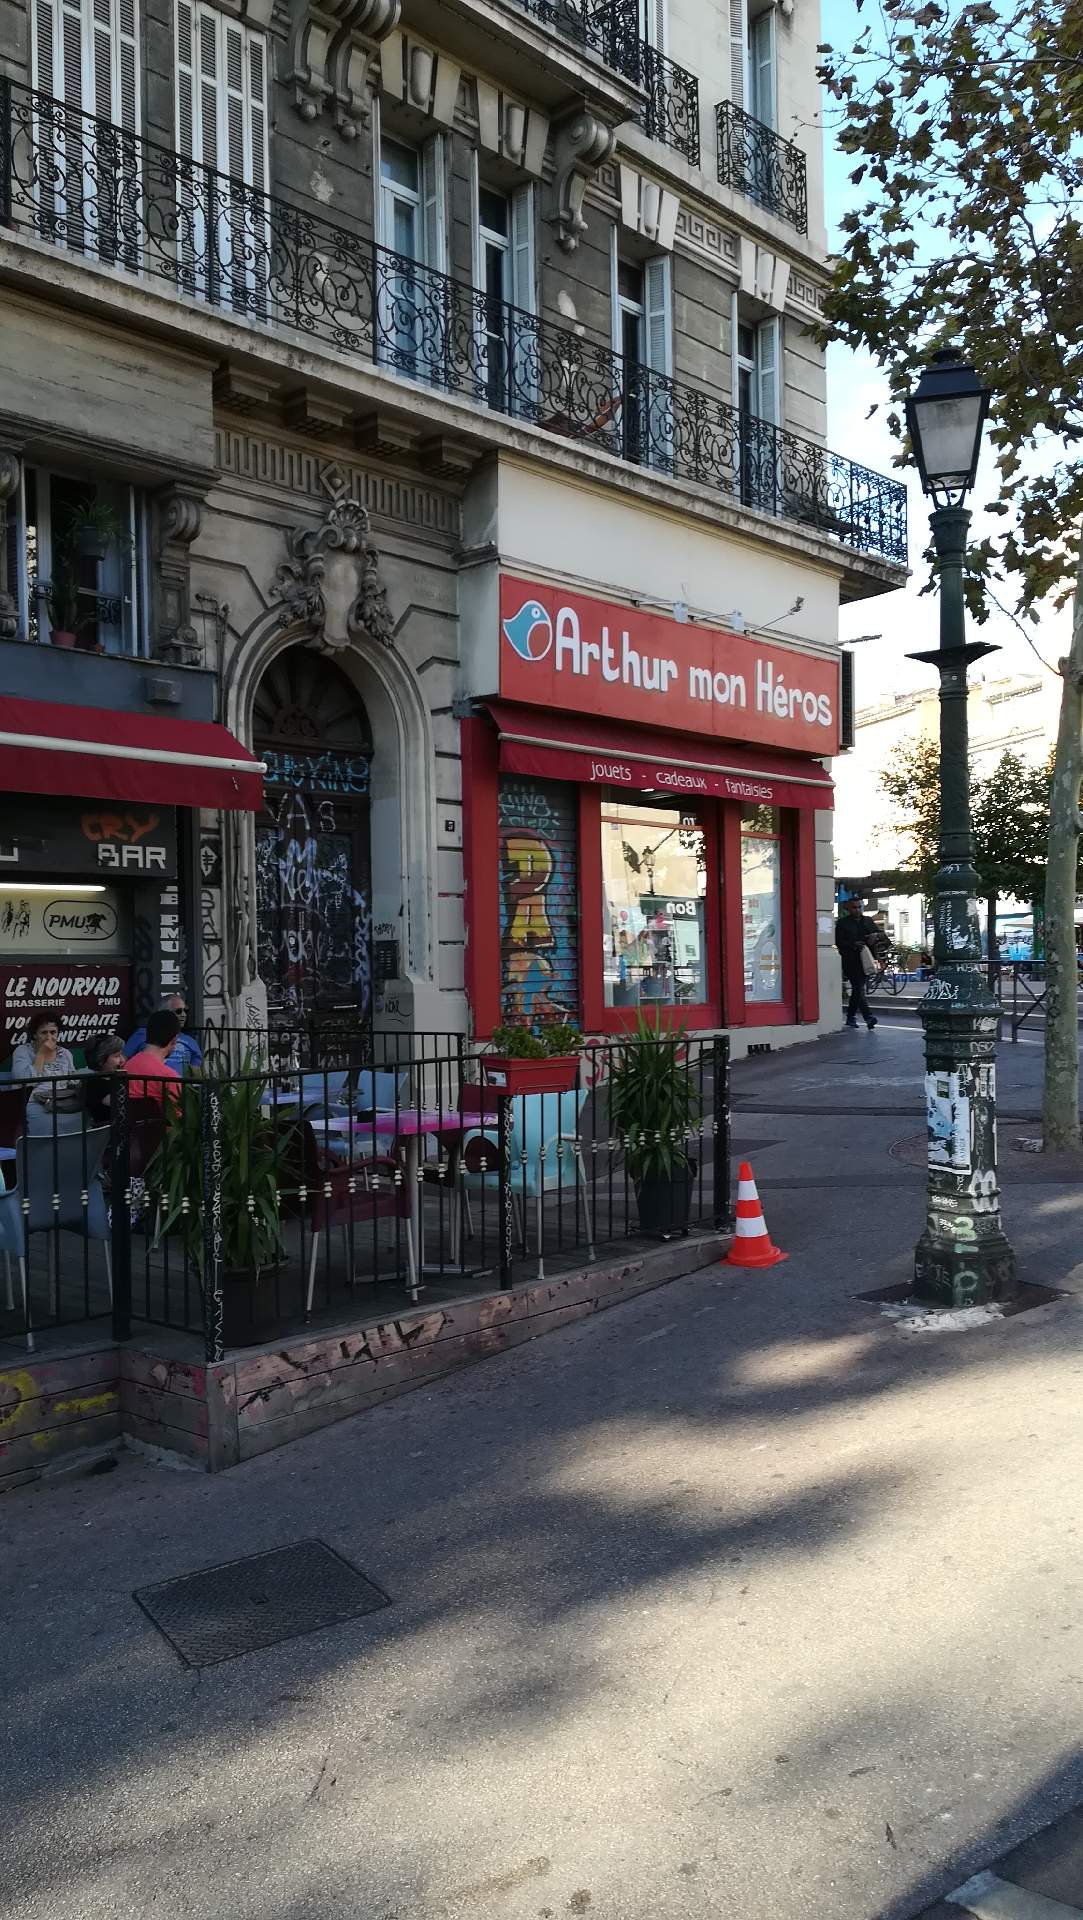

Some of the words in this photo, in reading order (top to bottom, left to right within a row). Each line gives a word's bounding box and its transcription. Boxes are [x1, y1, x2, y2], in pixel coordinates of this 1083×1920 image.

[555, 606, 678, 693] Arthur
[689, 665, 747, 708] mon
[756, 658, 833, 727] Héros
[590, 761, 631, 781] jouets
[656, 771, 707, 790] cadeaux
[725, 779, 773, 799] fantaisies
[98, 843, 166, 869] BAR
[49, 914, 86, 929] PMU
[160, 914, 180, 953] PMU
[160, 959, 180, 985] LE
[5, 977, 29, 997] LE
[32, 976, 120, 997] NOURYAD
[5, 998, 66, 1008] BRASSERIE
[97, 997, 121, 1006] PMU
[60, 1013, 120, 1027] OUHAITE
[10, 1031, 28, 1046] LA
